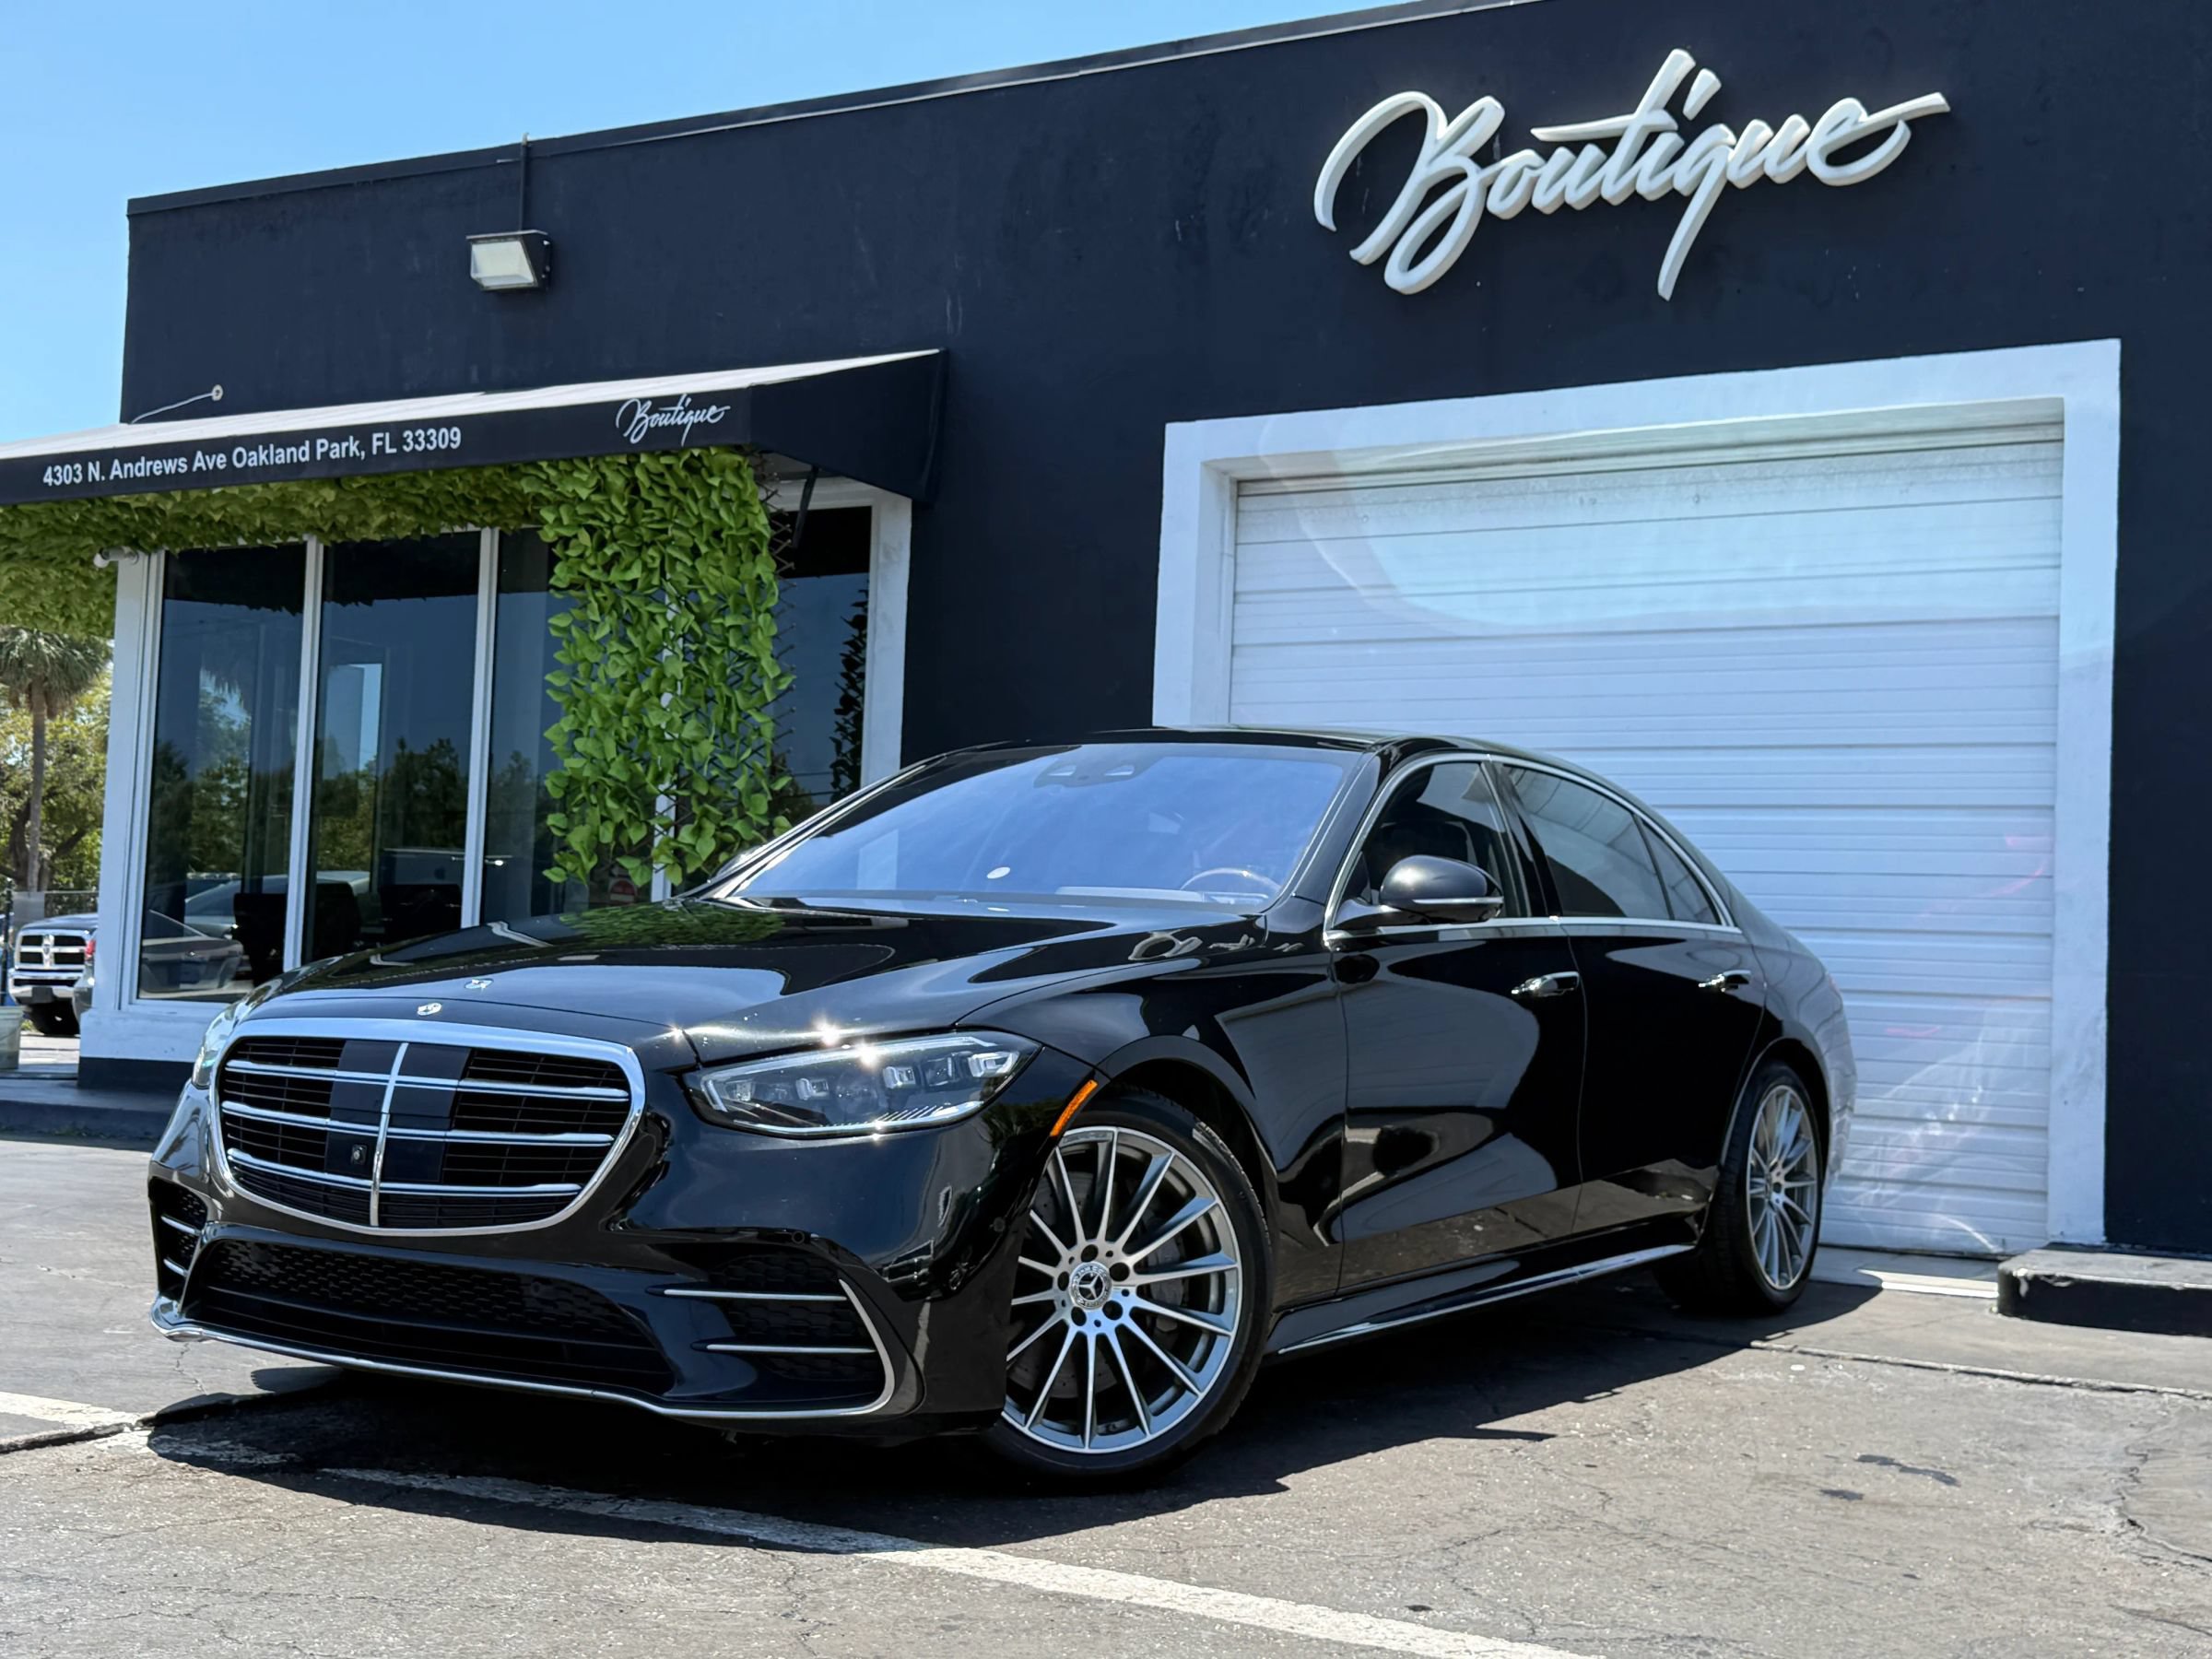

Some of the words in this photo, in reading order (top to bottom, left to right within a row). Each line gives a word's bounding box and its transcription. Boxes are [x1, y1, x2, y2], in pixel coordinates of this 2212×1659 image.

[1314, 49, 1950, 300] Boutique
[616, 394, 731, 446] Boutique
[42, 461, 83, 487] 4303
[88, 460, 106, 483] N.
[109, 455, 188, 480] Andrews
[192, 450, 228, 472] Ave
[231, 440, 311, 468] Oakland
[316, 435, 366, 461] Park,
[371, 431, 397, 455] FL
[402, 426, 462, 453] 33309
